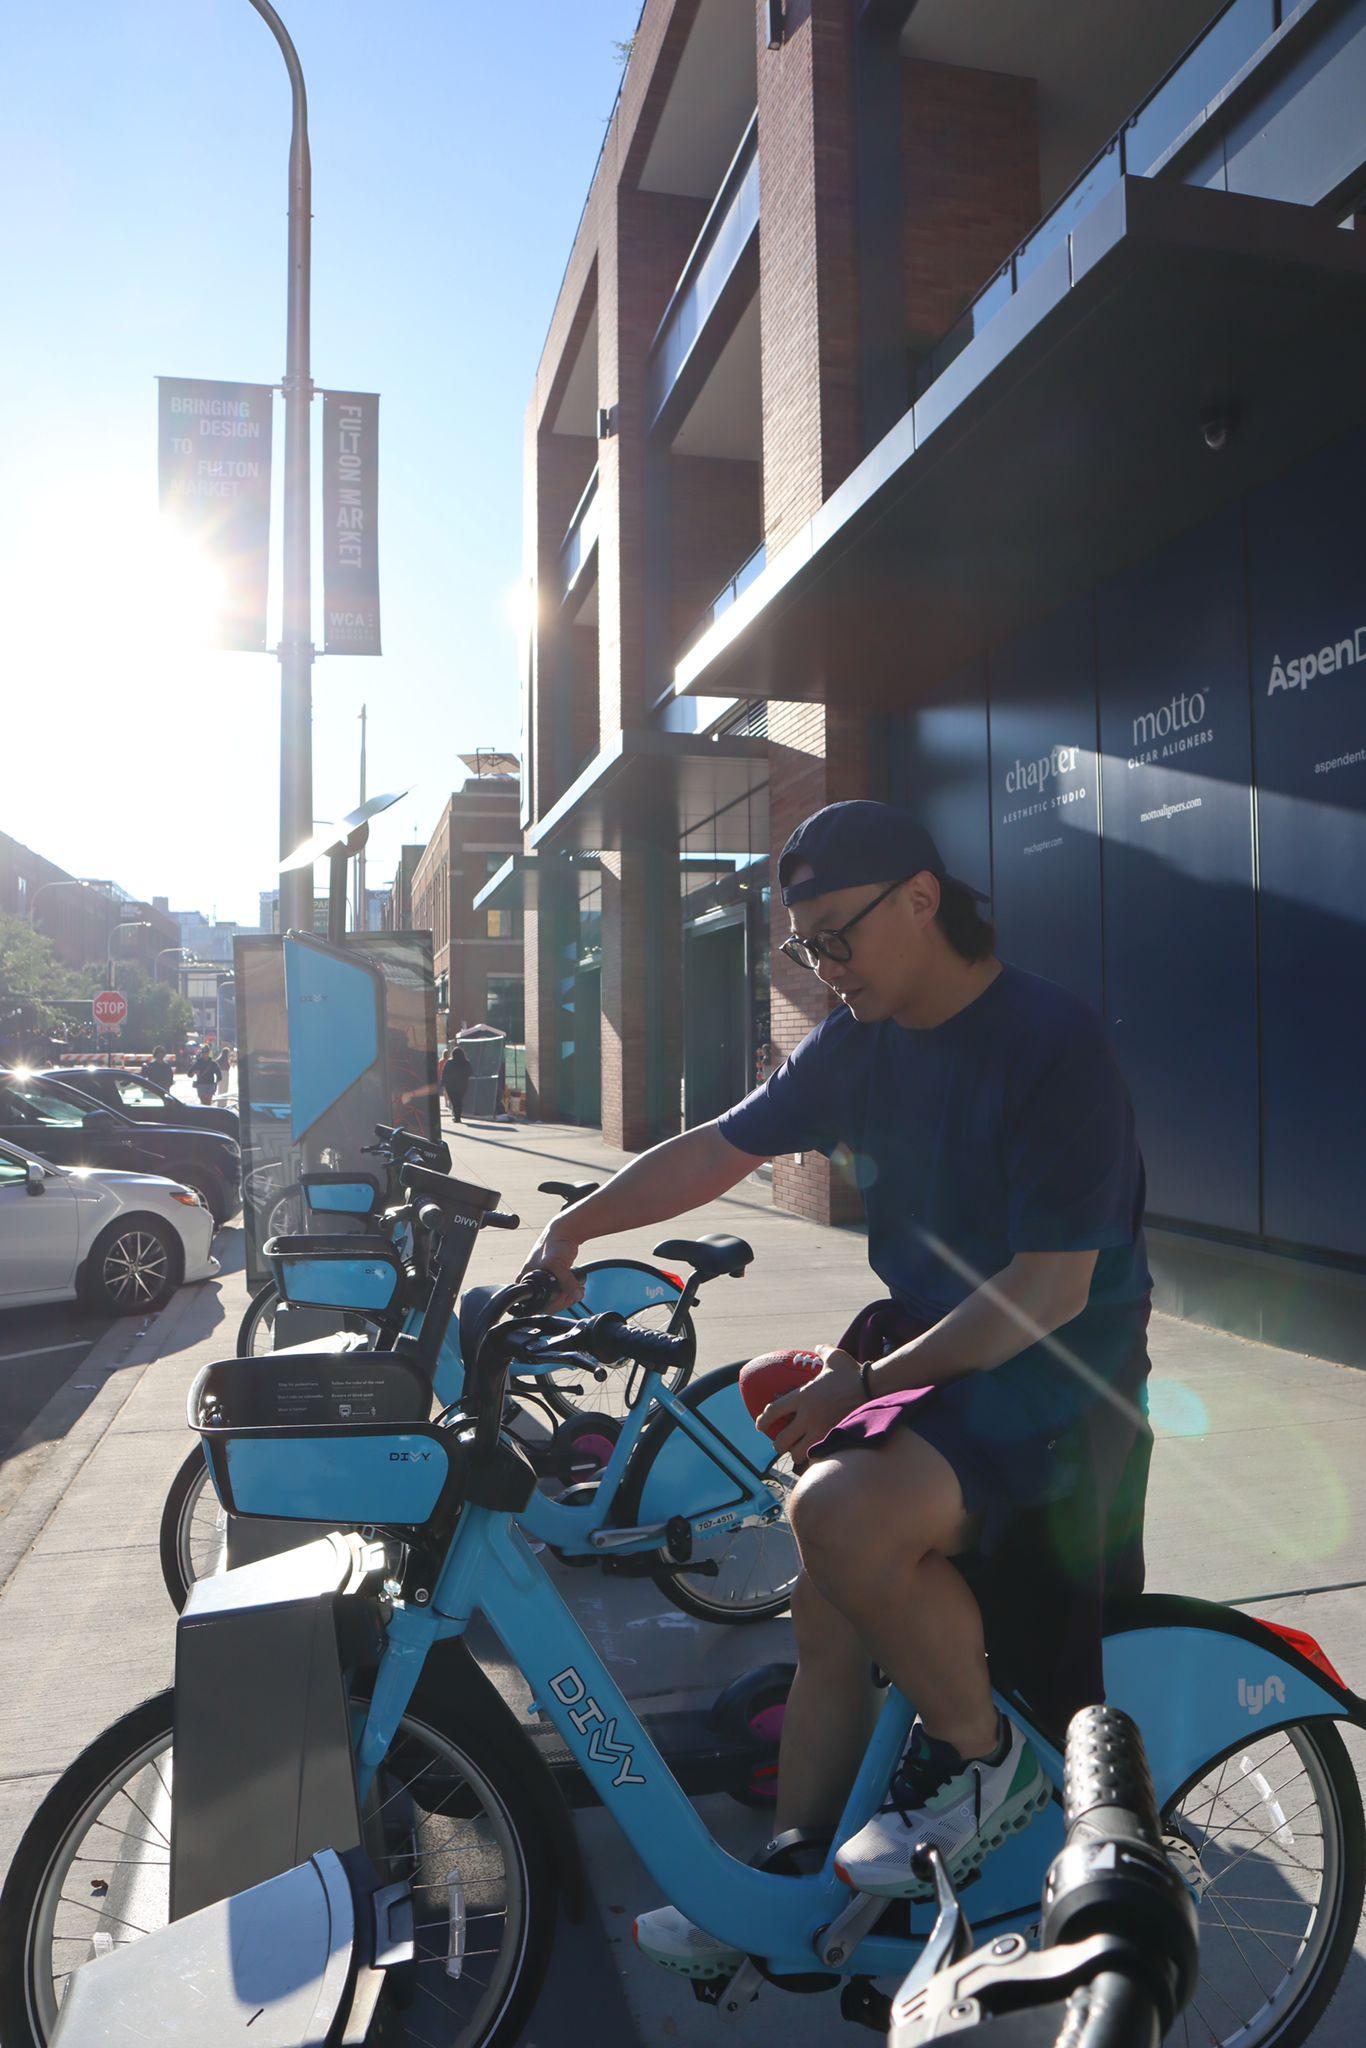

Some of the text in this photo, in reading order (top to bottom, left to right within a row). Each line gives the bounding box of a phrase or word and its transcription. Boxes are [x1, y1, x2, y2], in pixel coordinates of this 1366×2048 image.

[170, 397, 251, 417] BRINGING
[200, 419, 260, 438] DESIGN
[171, 438, 193, 455] TO
[197, 460, 259, 478] FULTON
[169, 480, 241, 497] MARKET
[336, 404, 364, 568] FULTON MARKET
[331, 612, 365, 627] WCA
[1128, 729, 1214, 770] CLEAR ALIGNERS
[1005, 745, 1080, 793] chapter
[1003, 788, 1086, 825] AESTHETIC STUDIO
[1140, 798, 1202, 823] mottoaligners.com
[96, 1002, 125, 1014] STOP
[454, 1214, 479, 1229] DIVVY
[1238, 1675, 1285, 1715] lyft
